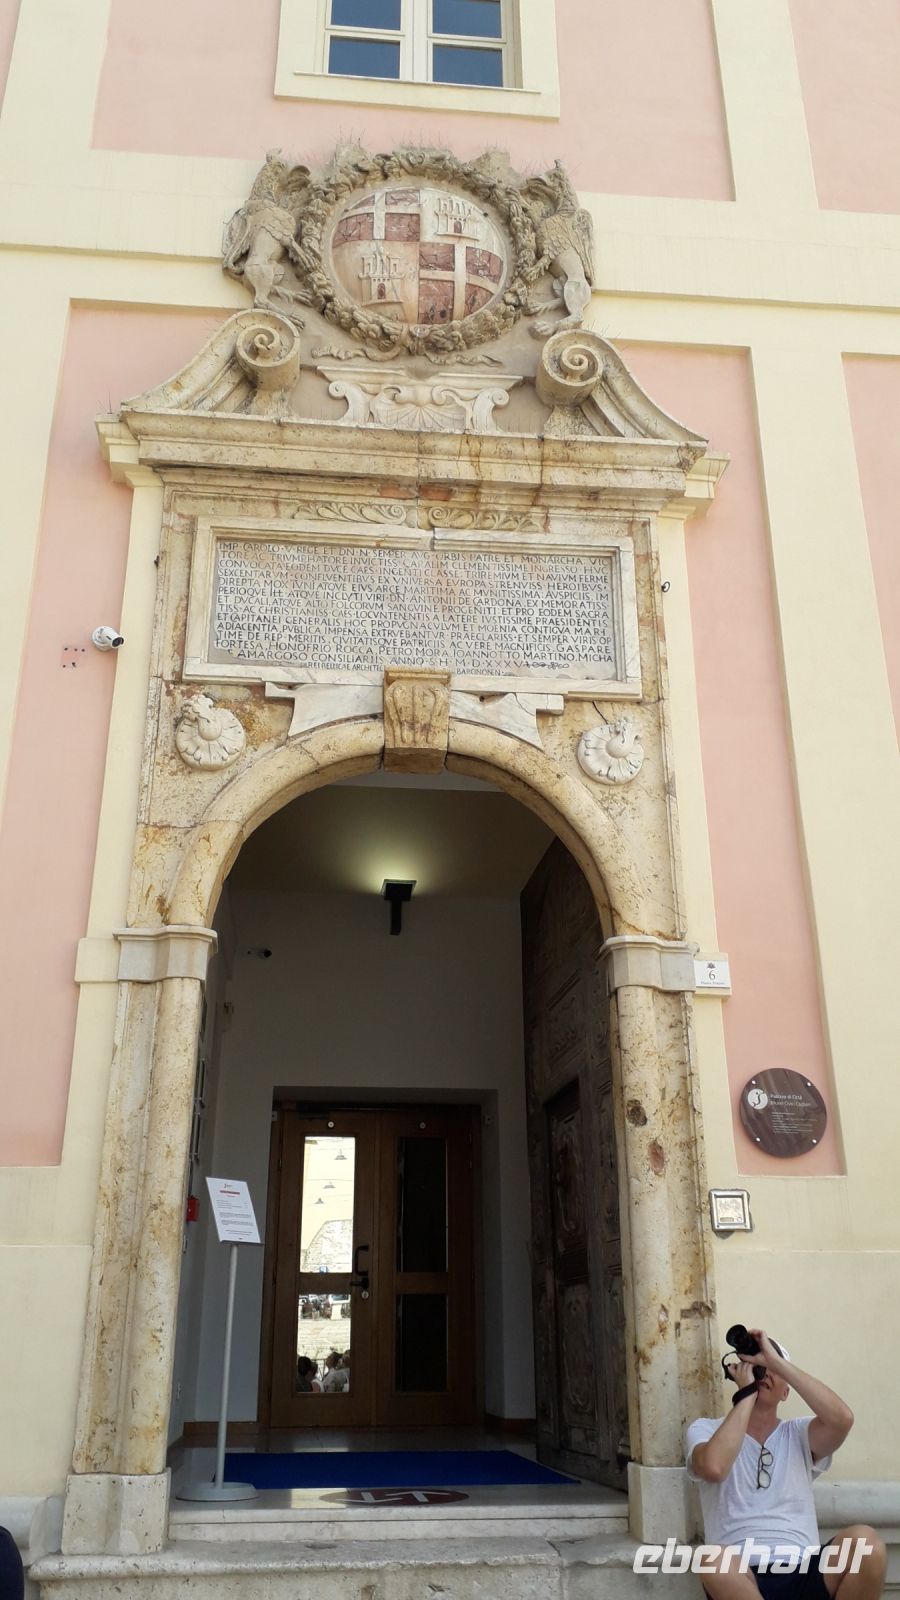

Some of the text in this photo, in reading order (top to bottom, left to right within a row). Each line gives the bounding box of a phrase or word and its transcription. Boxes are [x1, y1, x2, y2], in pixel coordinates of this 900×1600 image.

[221, 550, 248, 559] TORE
[270, 553, 348, 564] TRIVMPHATORE
[584, 566, 608, 574] HVC
[243, 543, 280, 552] CAROLO
[297, 546, 318, 554] REGE
[339, 547, 354, 556] DN
[373, 549, 406, 558] SEMPER
[436, 552, 465, 560] ORBIS
[470, 554, 500, 562] PATRE
[521, 555, 582, 565] MONARCHA
[219, 568, 288, 579] SEXCENTARVM
[393, 577, 442, 586] VNIVERSA
[446, 579, 486, 588] EVROPA
[220, 560, 282, 570] CONVOCATA
[286, 563, 320, 572] EODEM
[324, 565, 347, 573] DVCE
[380, 568, 421, 576] INGENTI
[424, 569, 459, 578] CLASSE
[464, 570, 519, 580] TRIREMIVM
[536, 574, 576, 582] NAVIVM
[579, 575, 608, 584] FERME
[219, 577, 260, 587] DIREPTA
[264, 579, 288, 588] MOX
[317, 582, 347, 592] ATQVE
[352, 584, 372, 592] EIVS
[375, 586, 400, 594] ARCE
[404, 586, 456, 596] MARITIMA
[474, 589, 540, 598] MVNITISSIMA
[288, 590, 320, 599] ATQVE
[366, 593, 384, 602] VIRI
[458, 597, 470, 606] DE
[218, 595, 229, 604] ET
[272, 598, 302, 606] ATQVE
[305, 600, 328, 608] ALTO
[331, 600, 384, 610] FOLCORVM
[387, 602, 440, 612] SANGVINE
[442, 605, 496, 614] PROGENITI
[502, 607, 513, 615] ET
[516, 608, 534, 616] PRO
[538, 608, 572, 617] EODEM
[575, 610, 609, 618] SACRA
[243, 606, 256, 614] AC
[443, 614, 478, 624] LATERE
[482, 616, 532, 624] IVSTISSIME
[536, 617, 608, 628] PRAESIDENTIS
[218, 612, 228, 621] ET
[230, 613, 281, 624] CAPITANEI
[285, 616, 341, 626] GENERALIS
[344, 619, 367, 628] HOC
[464, 624, 476, 632] ET
[521, 626, 570, 634] CONTIGVA
[218, 630, 242, 639] TIME
[248, 632, 260, 640] DE
[332, 636, 398, 646] CIVITATISQVE
[450, 641, 462, 649] AC
[466, 642, 490, 650] VERE
[556, 644, 611, 653] GASPARE
[283, 625, 322, 635] PVBLICA
[324, 627, 368, 636] IMPENSA
[372, 628, 444, 639] EXTRVEBANTVR
[518, 634, 529, 642] ET
[532, 634, 568, 644] SEMPER
[570, 636, 597, 644] VIRIS
[599, 636, 612, 644] OP
[238, 650, 308, 661] AMARGOSO
[390, 656, 424, 666] ANNO
[269, 642, 331, 652] HONOFRIO
[379, 646, 412, 656] PETRO
[416, 648, 448, 658] MORA
[579, 653, 613, 662] MICHA
[709, 970, 716, 980] 6
